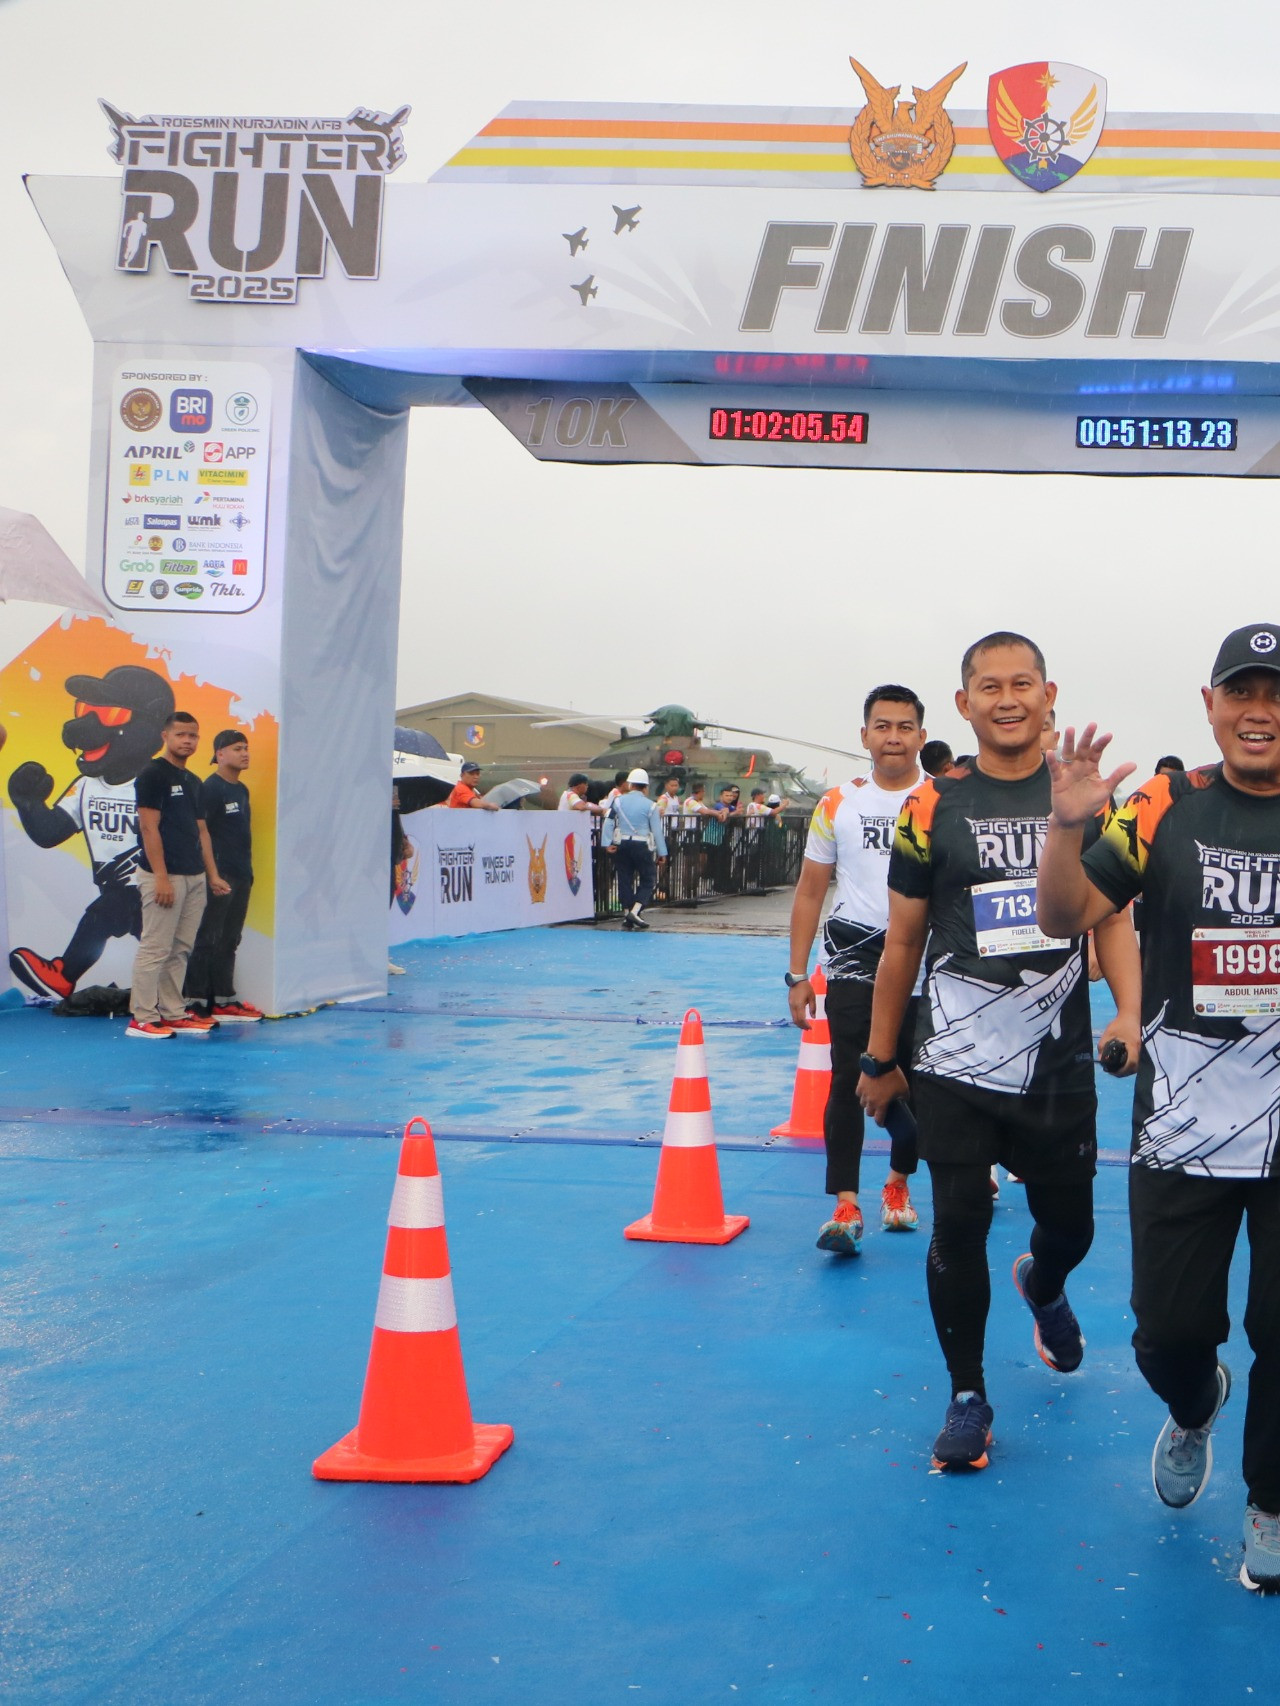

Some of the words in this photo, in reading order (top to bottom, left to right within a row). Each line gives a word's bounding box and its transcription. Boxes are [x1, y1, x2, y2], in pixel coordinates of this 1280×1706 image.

[160, 117, 230, 129] ROESMIN
[232, 118, 309, 131] NURJADIN
[311, 119, 343, 131] AFB
[126, 131, 386, 171] FIGHTER
[118, 169, 384, 277] RUN
[189, 274, 295, 299] 2025
[738, 220, 1195, 339] FINISH
[121, 372, 187, 382] SPONSORED
[188, 374, 203, 382] BY
[176, 396, 207, 414] BRI
[180, 415, 206, 426] mo
[525, 397, 638, 448] 10K
[711, 408, 863, 443] 01:02:05.54
[1079, 418, 1232, 448] 00:51:13.23
[123, 445, 183, 460] APRIL
[225, 446, 256, 460] APP
[199, 470, 245, 479] VITACIMIN
[147, 517, 178, 528] Salonpas
[187, 514, 222, 526] wmk
[189, 541, 207, 549] BANK
[207, 542, 243, 550] INDONESIA
[119, 559, 155, 573] Grab
[162, 562, 196, 573] Fitbar
[203, 559, 226, 569] AQUA
[89, 811, 140, 834] RUN
[863, 819, 897, 828] FIGH
[975, 821, 1049, 834] FIGHTE
[101, 833, 124, 841] 2025
[439, 852, 474, 866] FIGHTER
[481, 856, 504, 869] WINGS
[505, 855, 515, 868] UP
[485, 871, 500, 884] RUN
[1005, 868, 1038, 877] 2025
[441, 866, 473, 904] RUN
[990, 894, 1037, 920] 713
[1230, 914, 1274, 925] 2025
[1011, 927, 1036, 936] FIDELLE
[1224, 988, 1251, 996] ABDUL
[1253, 987, 1278, 996] HARIS
